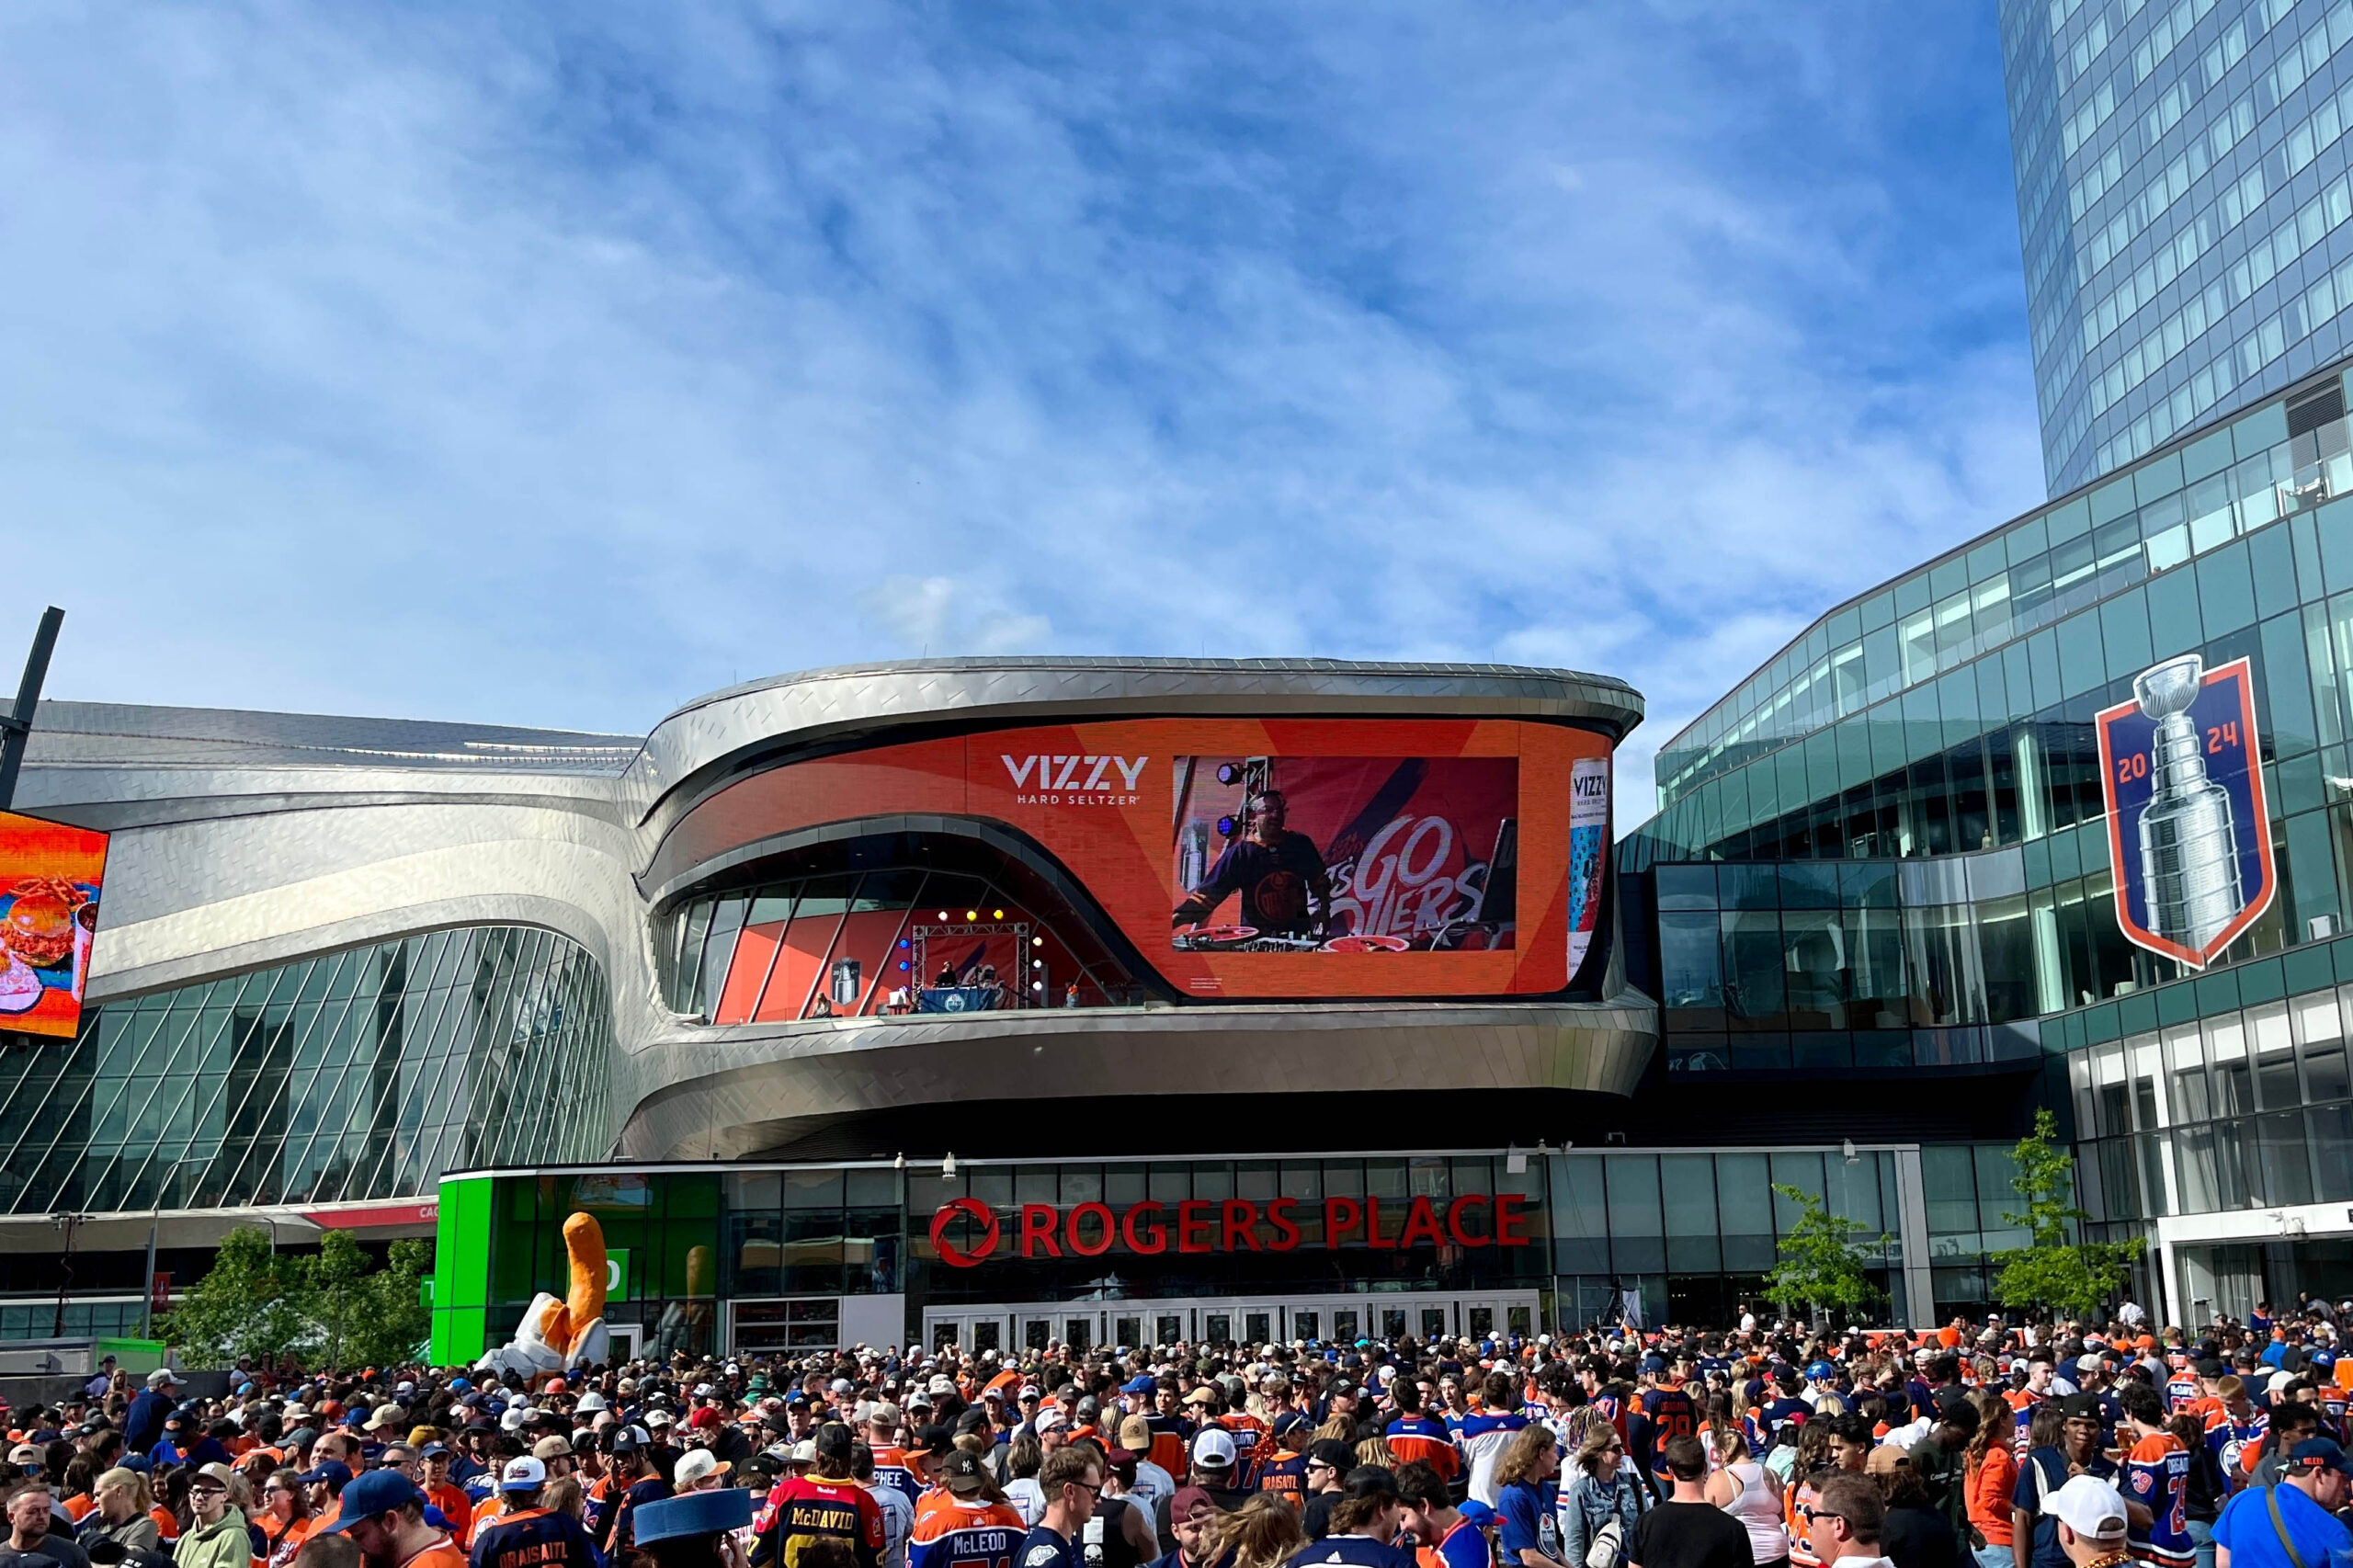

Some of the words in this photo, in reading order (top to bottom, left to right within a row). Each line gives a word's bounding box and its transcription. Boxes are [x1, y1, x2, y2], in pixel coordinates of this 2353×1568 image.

[2118, 753, 2146, 783] 20
[2207, 721, 2238, 755] 24
[1000, 755, 1149, 791] VIZZY
[1574, 775, 1607, 797] VIZZY
[1017, 794, 1060, 805] HARD
[1068, 795, 1138, 806] SELTZER
[1021, 1197, 1302, 1257] ROGERS
[1324, 1193, 1529, 1250] PLACE
[873, 1471, 902, 1487] PHEE
[791, 1507, 854, 1530] McDAVID
[499, 1541, 568, 1568] DRAISAITL
[953, 1531, 1007, 1555] McLEOD
